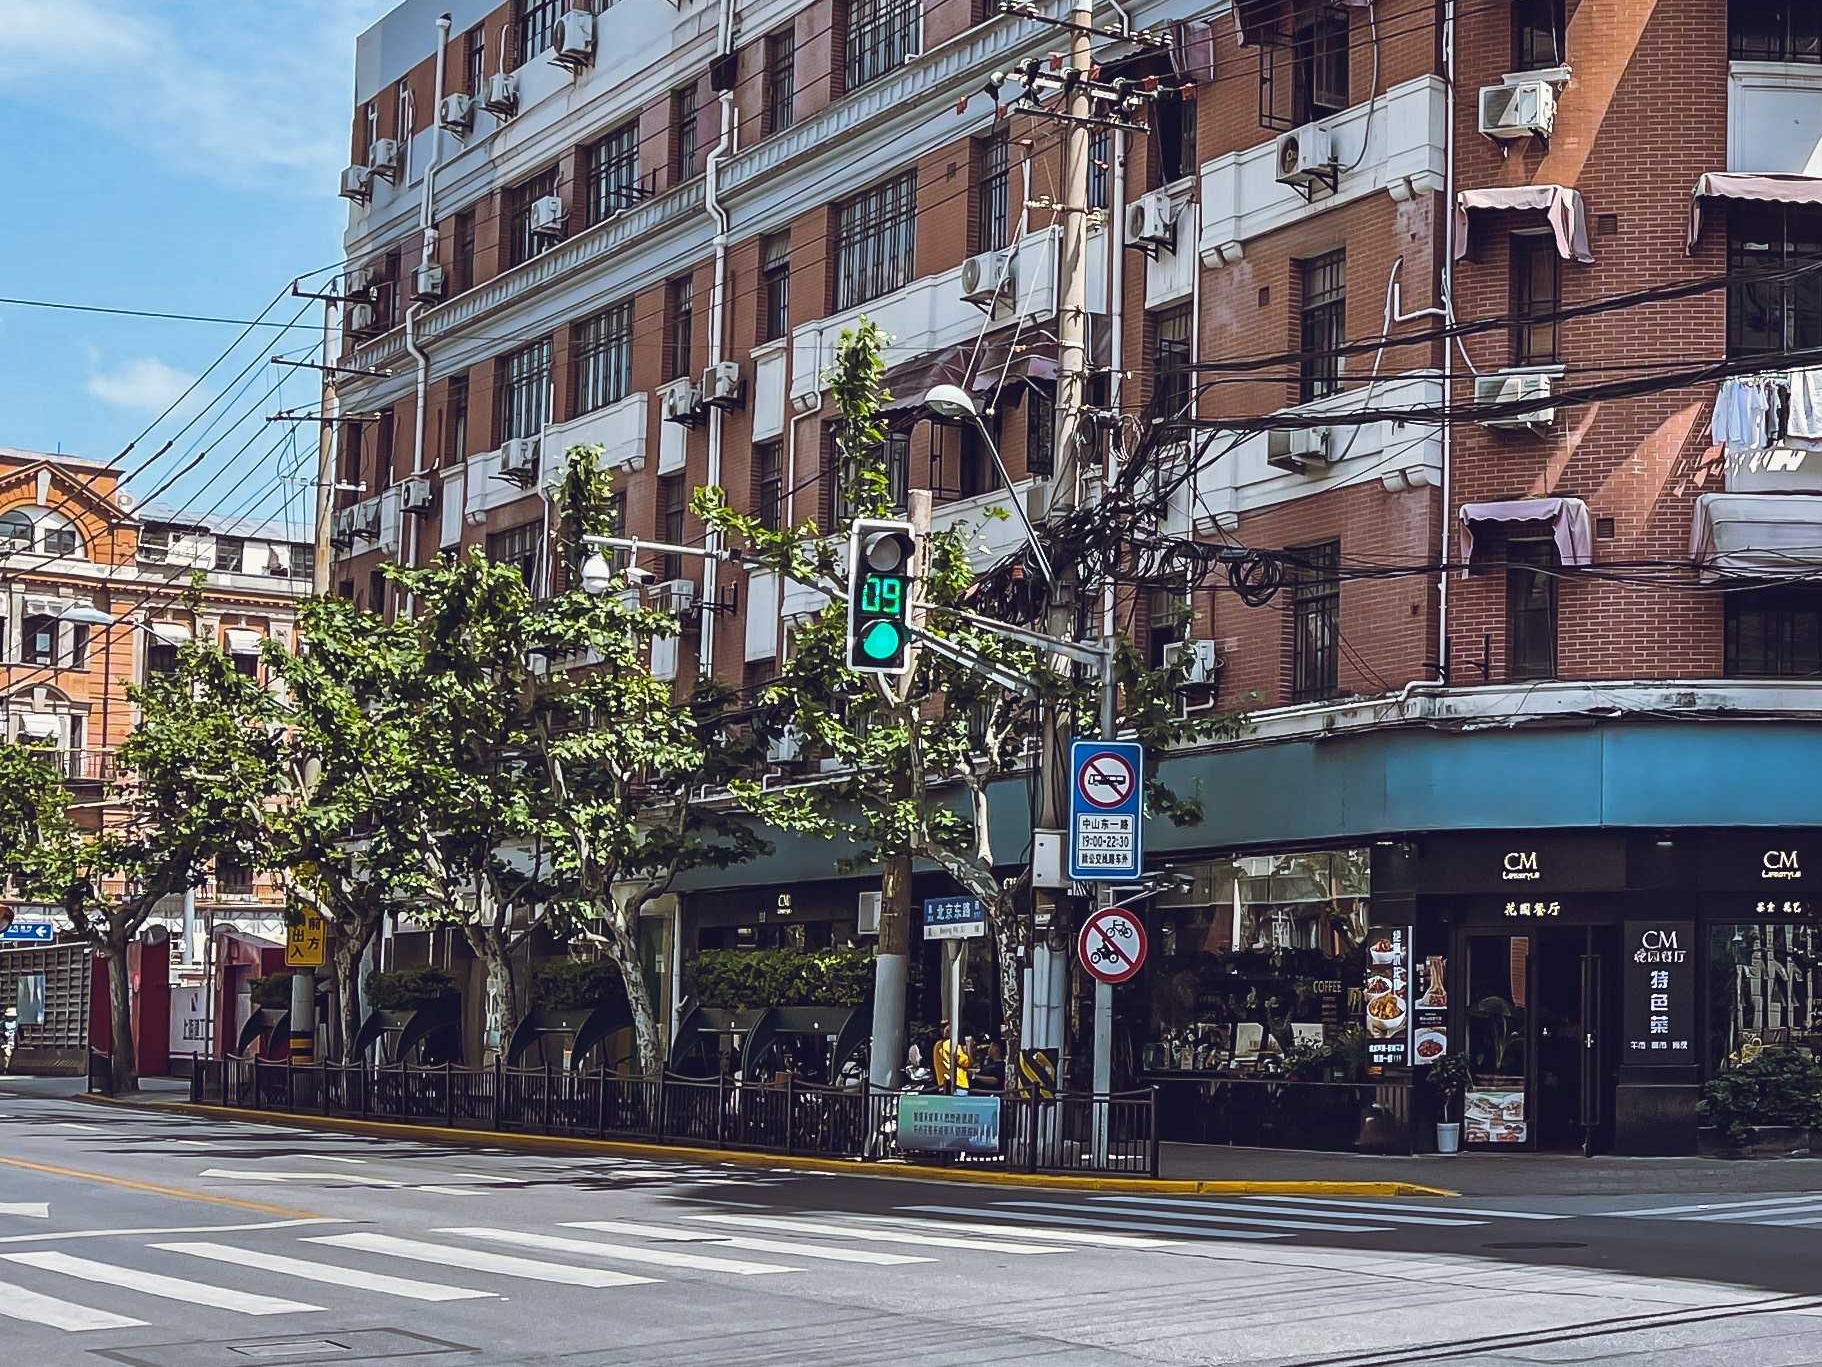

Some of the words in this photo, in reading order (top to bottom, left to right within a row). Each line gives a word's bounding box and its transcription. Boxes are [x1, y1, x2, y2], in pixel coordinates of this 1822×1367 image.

[861, 574, 901, 614] 09
[1082, 818, 1129, 830] 中山东一路
[1082, 835, 1129, 848] 19:00-22:30
[1504, 851, 1538, 870] CM
[1763, 850, 1799, 869] CM
[936, 901, 971, 920] 北京东路
[1503, 901, 1561, 917] 花园餐厅
[1642, 930, 1678, 949] CM
[1634, 949, 1687, 963] 花园餐厅
[1313, 980, 1342, 993] COFFEE
[1650, 970, 1669, 1034] 特色菜
